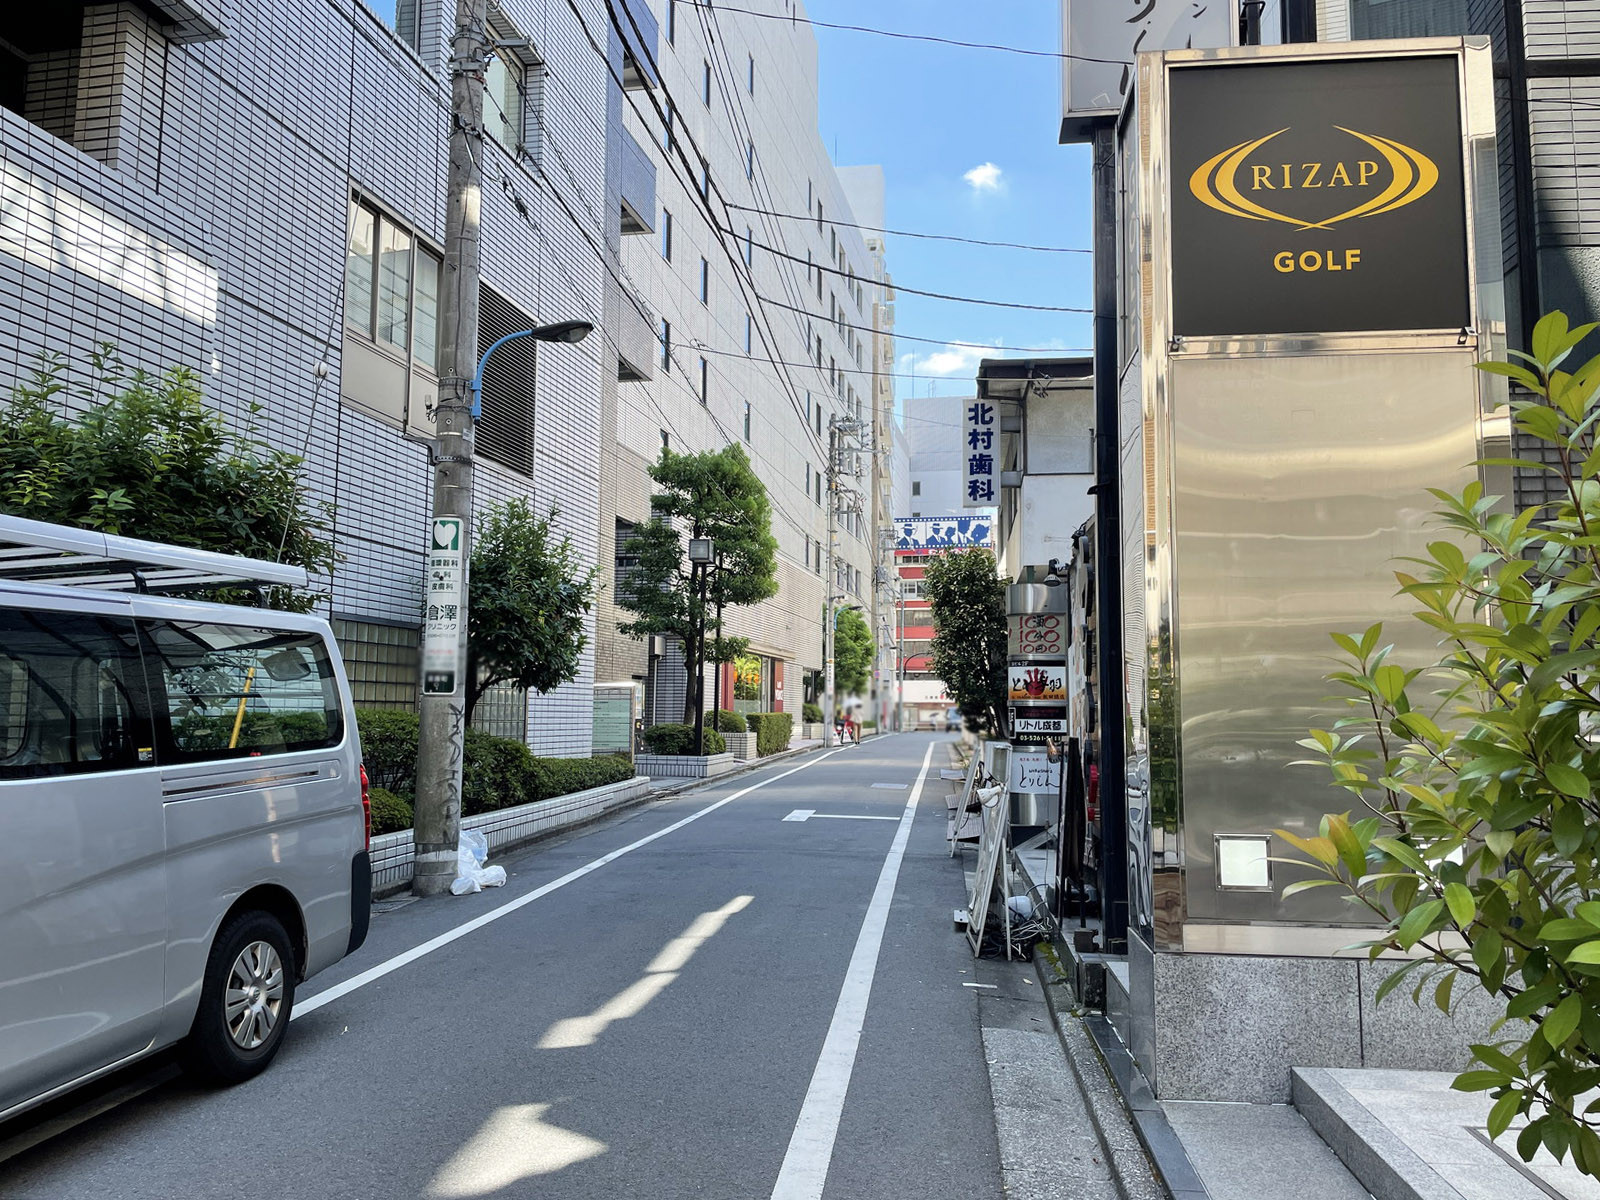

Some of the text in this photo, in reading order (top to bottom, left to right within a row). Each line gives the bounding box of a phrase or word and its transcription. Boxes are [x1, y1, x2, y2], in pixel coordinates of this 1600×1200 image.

[1251, 160, 1379, 190] RIZAP
[1273, 249, 1361, 273] GOLF
[968, 403, 994, 501] 北村歯科
[427, 623, 457, 631] クリニック
[1019, 720, 1061, 731] リトル成都
